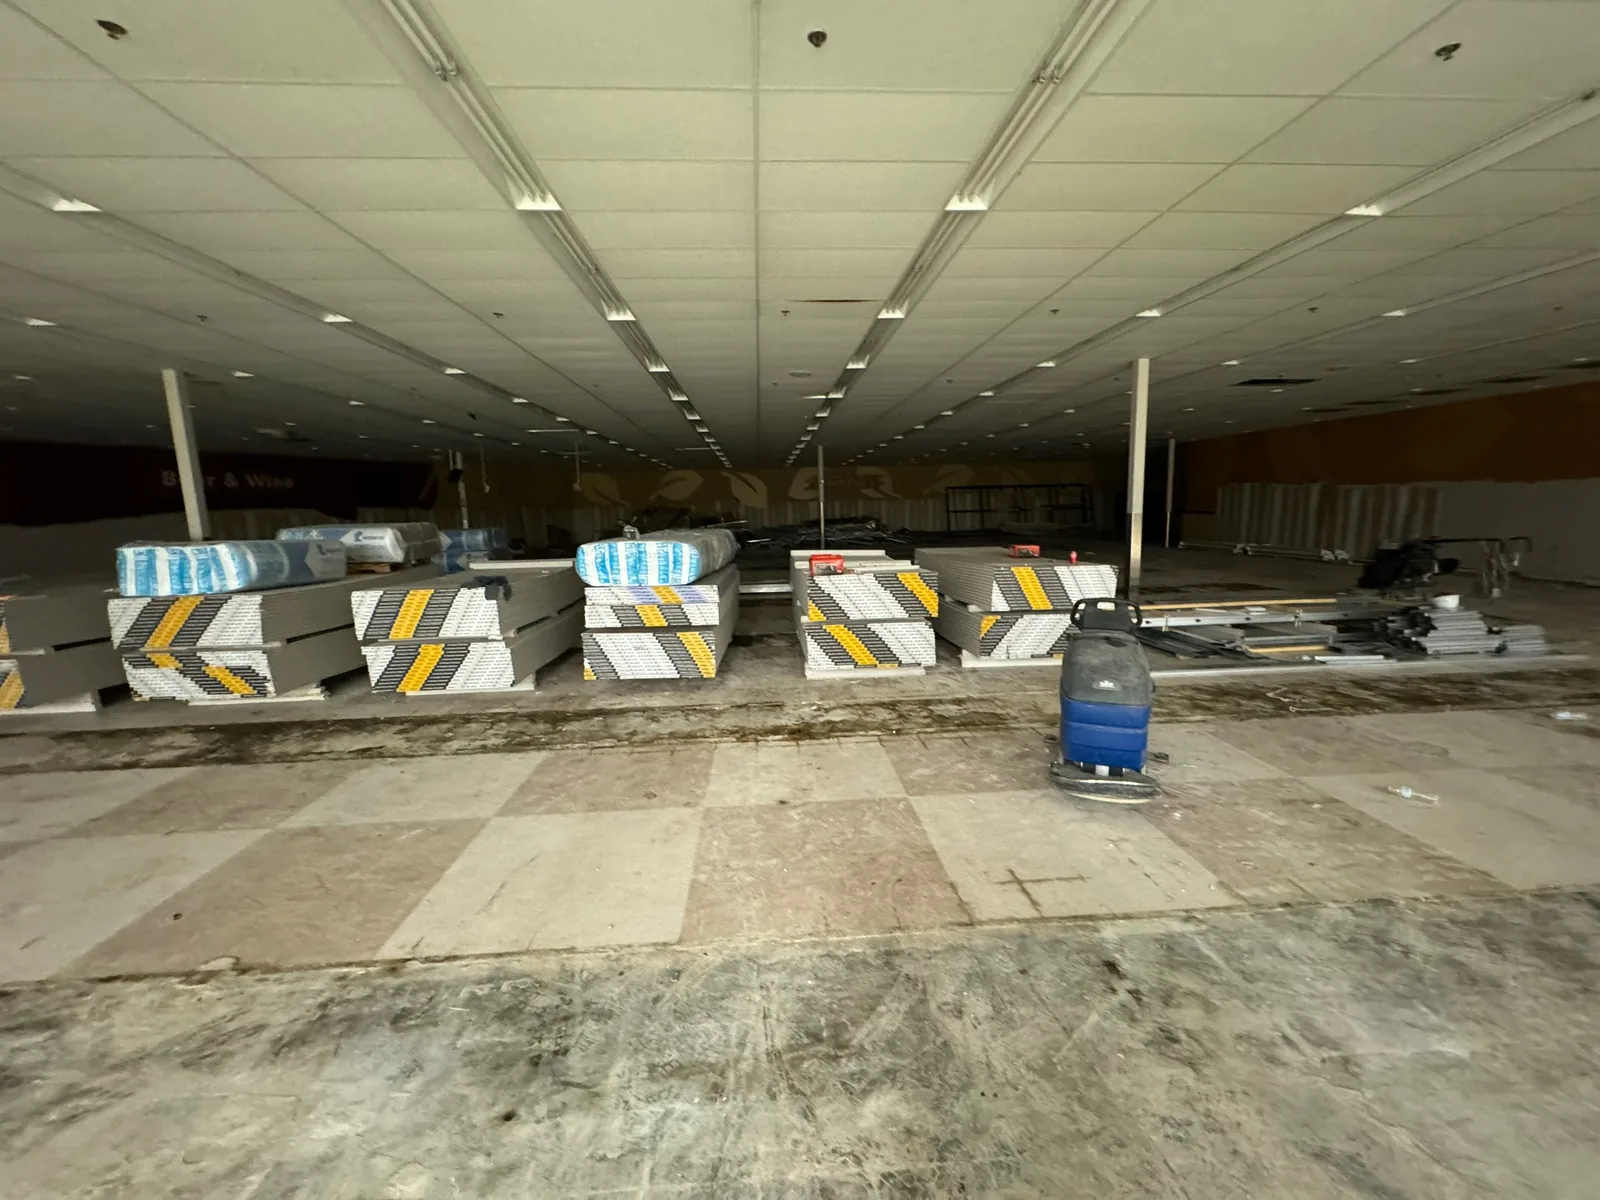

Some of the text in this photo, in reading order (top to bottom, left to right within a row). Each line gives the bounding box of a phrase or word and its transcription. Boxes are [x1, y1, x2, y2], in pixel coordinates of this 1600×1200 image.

[161, 470, 295, 492] Br & Wine
